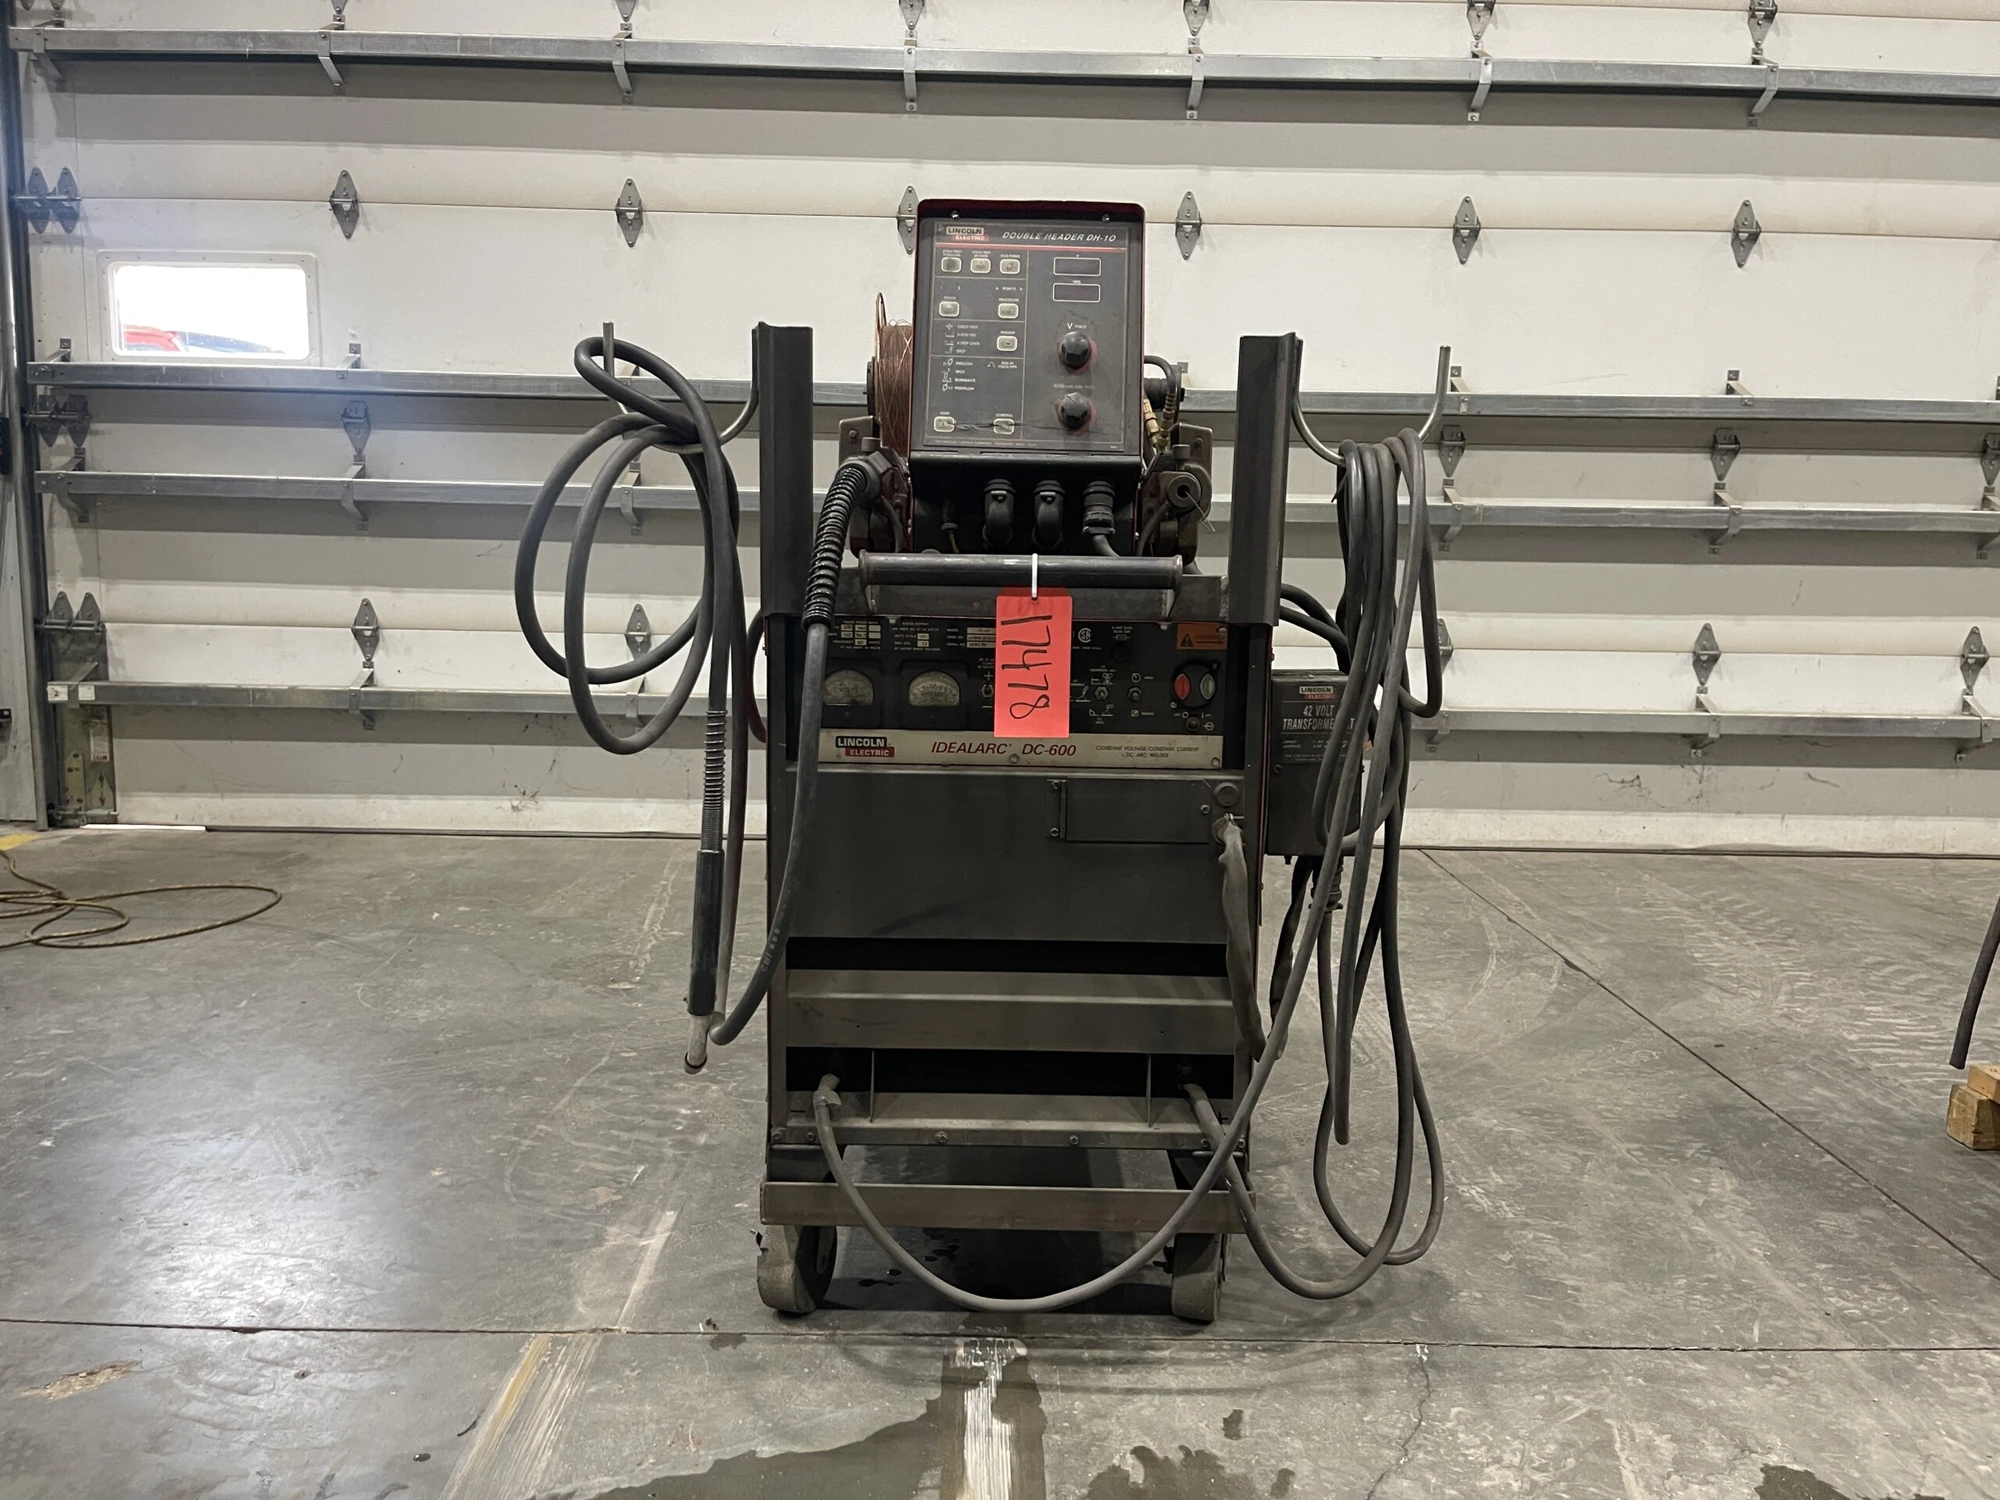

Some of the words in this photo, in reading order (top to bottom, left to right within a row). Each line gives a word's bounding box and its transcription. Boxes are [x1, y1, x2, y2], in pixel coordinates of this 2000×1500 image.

[1002, 231, 1043, 240] DOUBLE
[1044, 233, 1085, 241] HEADER
[1086, 234, 1117, 242] DH-10
[1066, 322, 1074, 330] V
[1001, 615, 1053, 719] 17478
[1303, 705, 1313, 717] 42
[1315, 704, 1335, 717] VOLT
[1283, 718, 1335, 730] TRANSFORME
[837, 738, 885, 747] LINCOLN
[850, 749, 890, 757] ELECTRIC
[931, 741, 1008, 755] IDEALARC
[1021, 743, 1077, 756] DC-600
